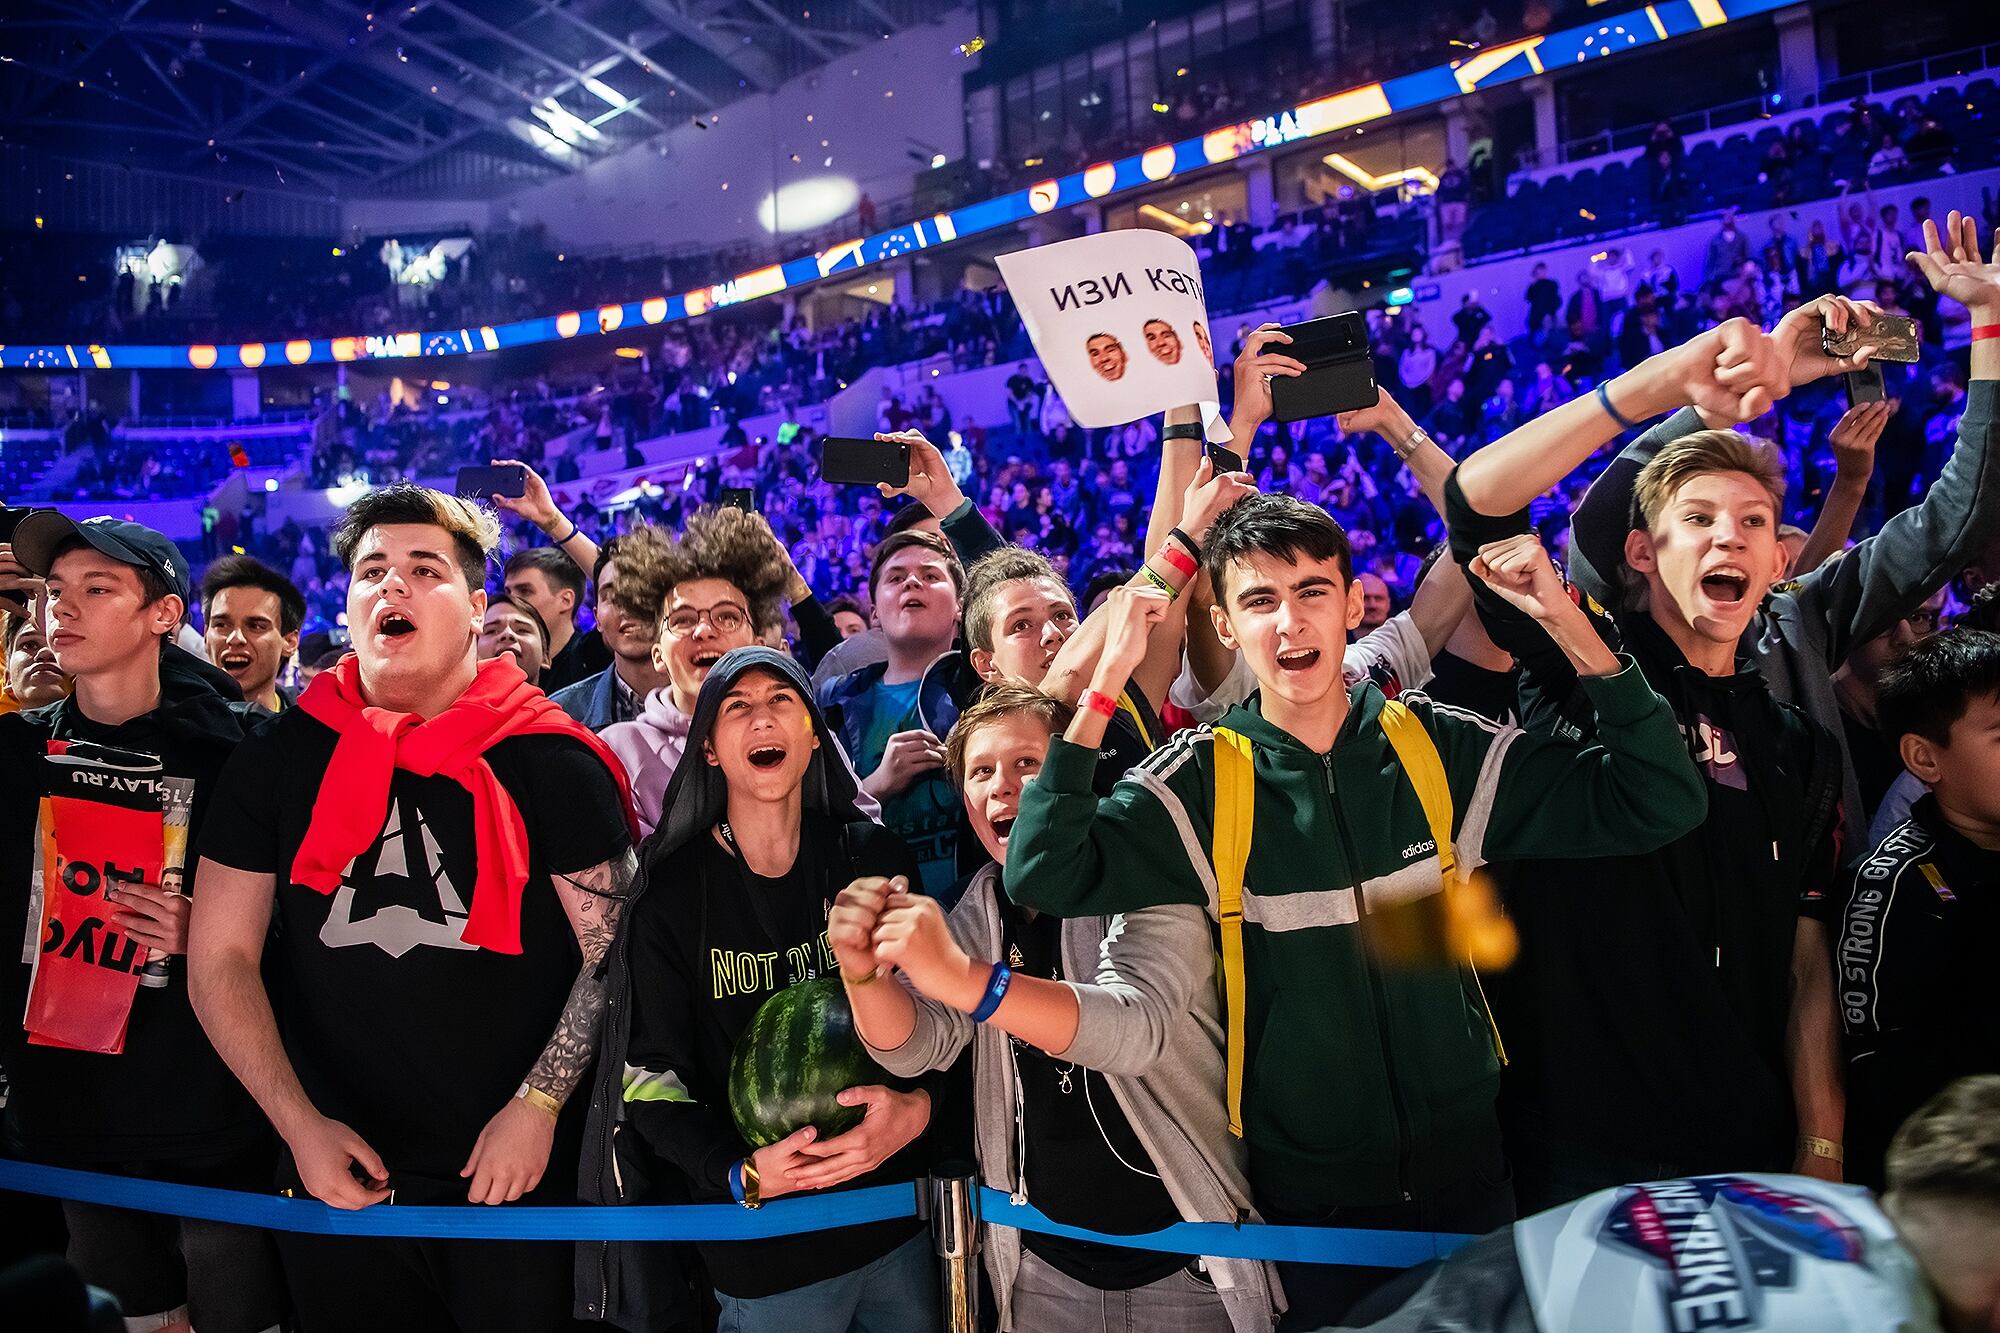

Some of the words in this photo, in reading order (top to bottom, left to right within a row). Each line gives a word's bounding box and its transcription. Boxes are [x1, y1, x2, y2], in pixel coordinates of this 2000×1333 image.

[1050, 272, 1133, 311] изи
[1401, 839, 1436, 859] adidas
[1862, 856, 1899, 880] GO
[1842, 889, 1883, 984] STRONG
[711, 948, 778, 999] NOT
[1843, 991, 1868, 1024] GO
